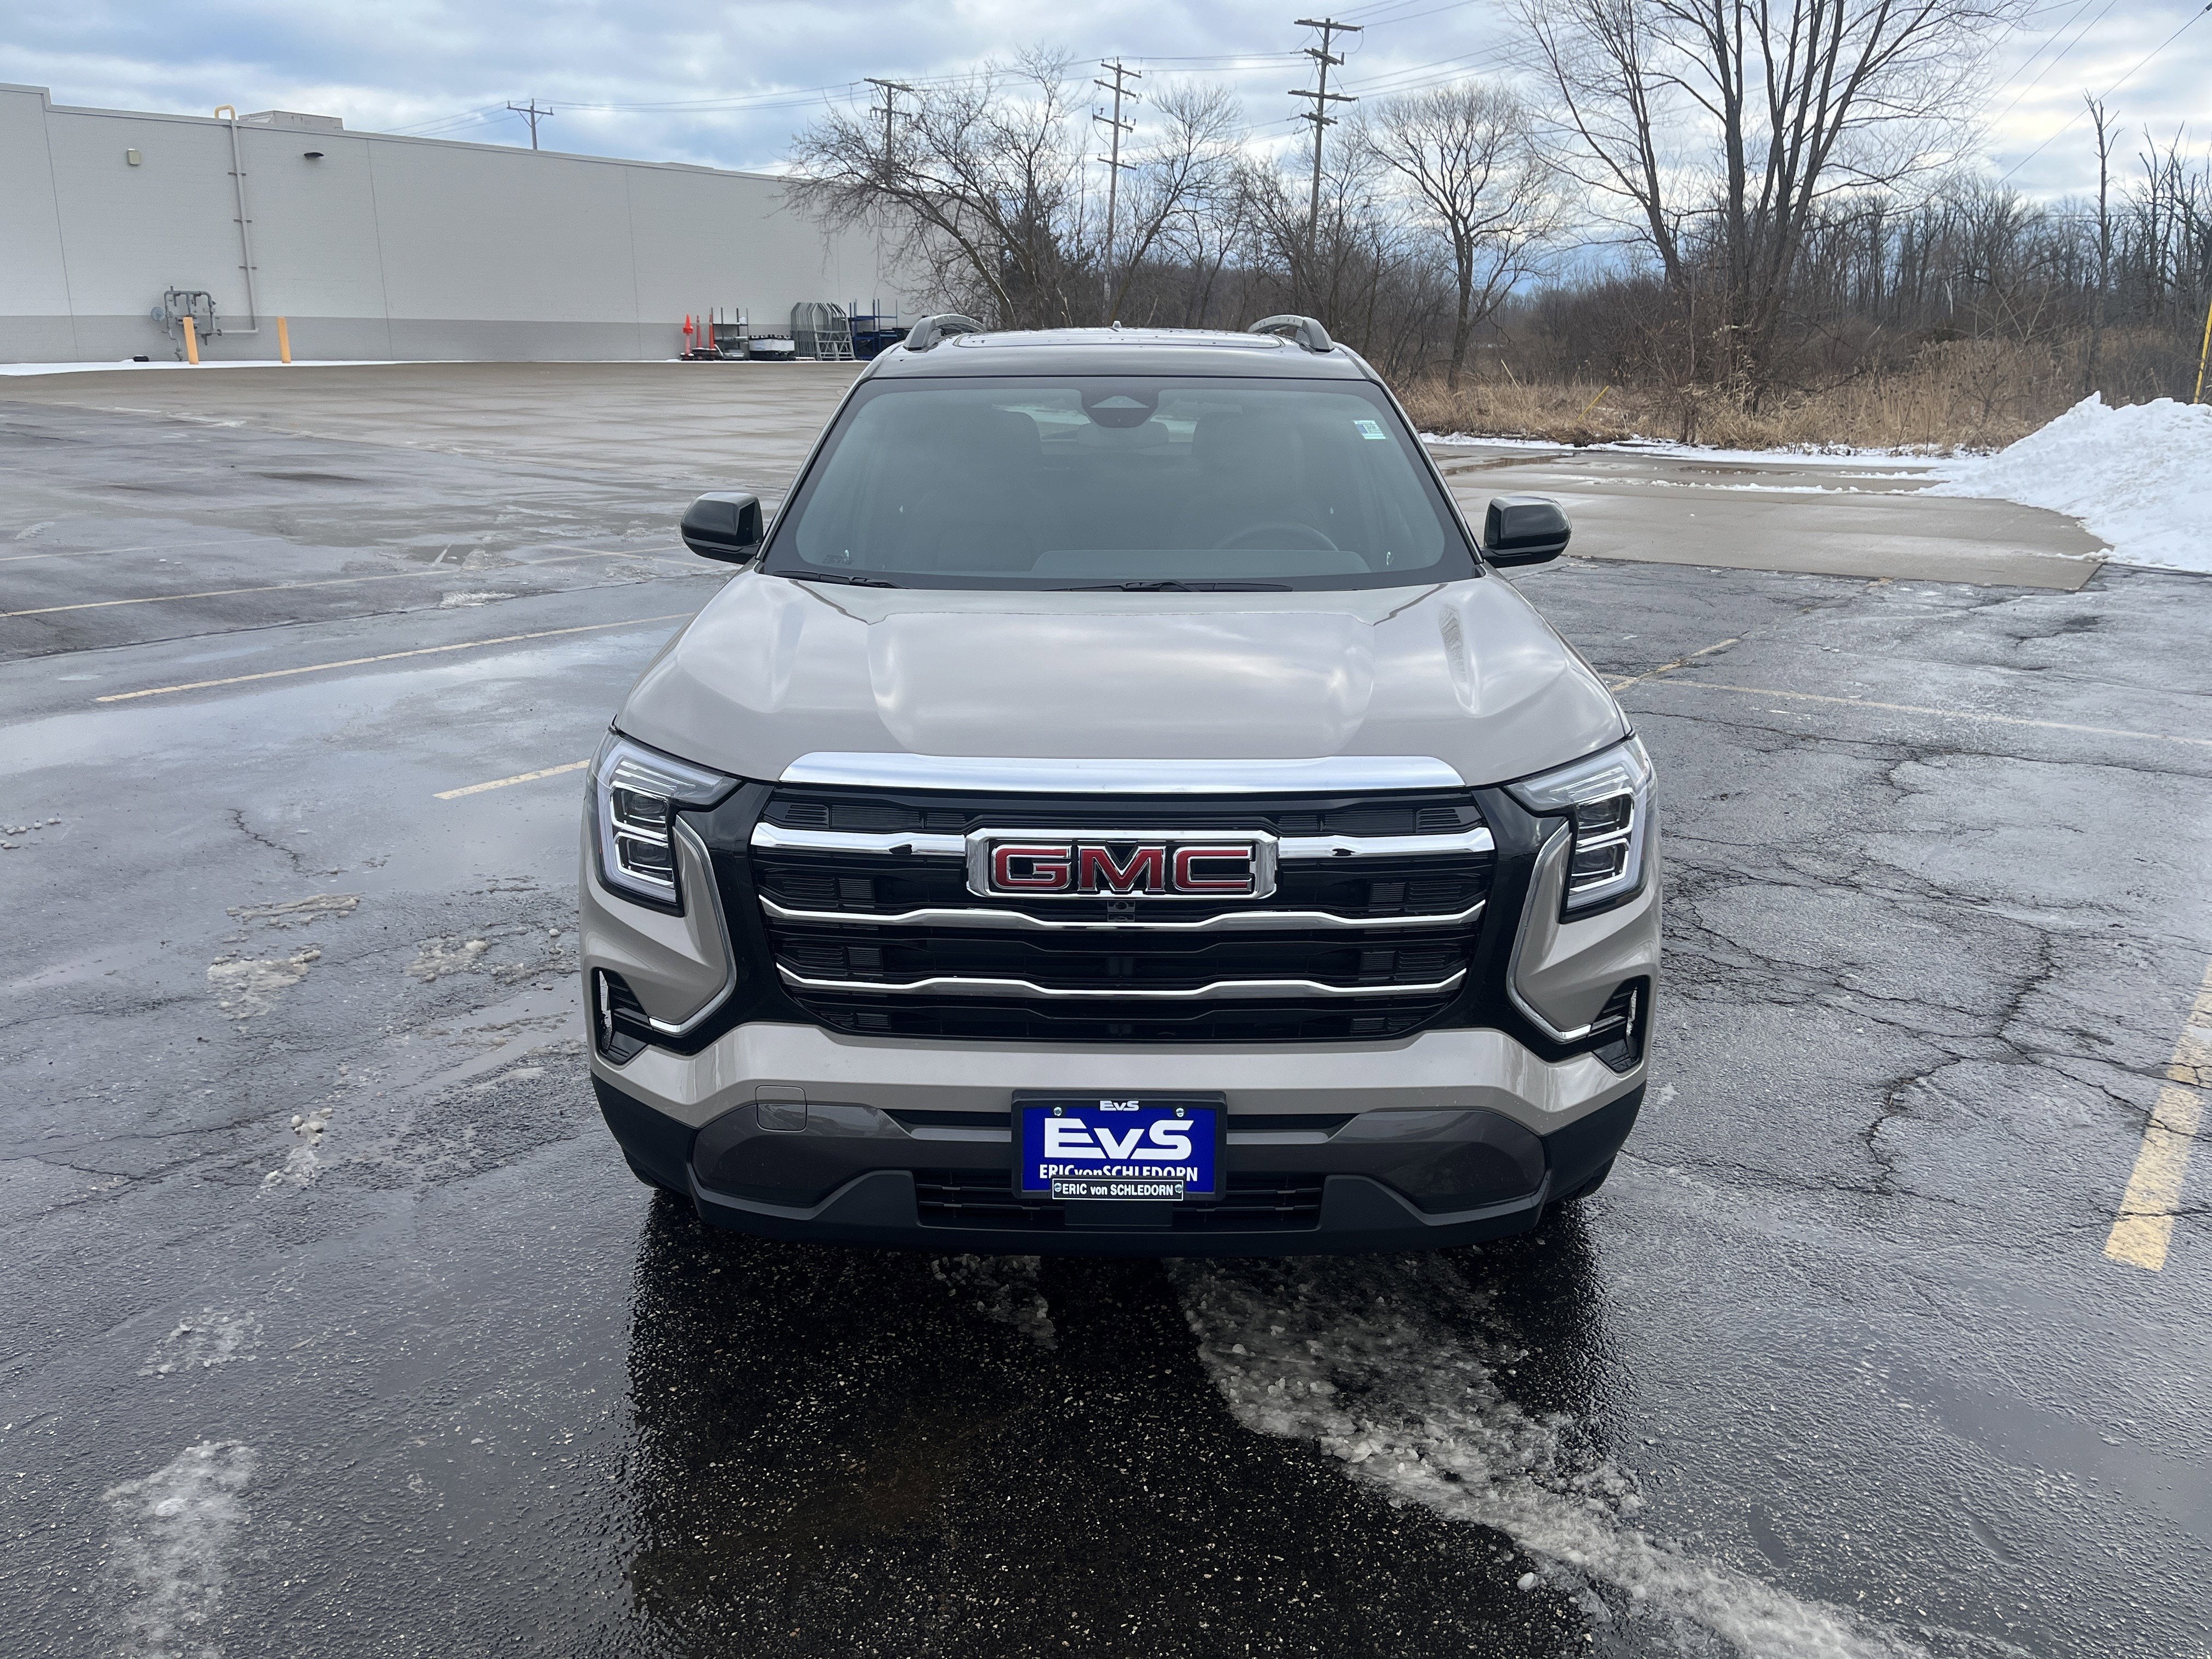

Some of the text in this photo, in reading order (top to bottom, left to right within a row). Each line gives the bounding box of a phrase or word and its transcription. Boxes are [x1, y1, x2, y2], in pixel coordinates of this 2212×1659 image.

[991, 844, 1252, 894] GMC
[1062, 1183, 1173, 1196] ERIC von SCHLEDORN
